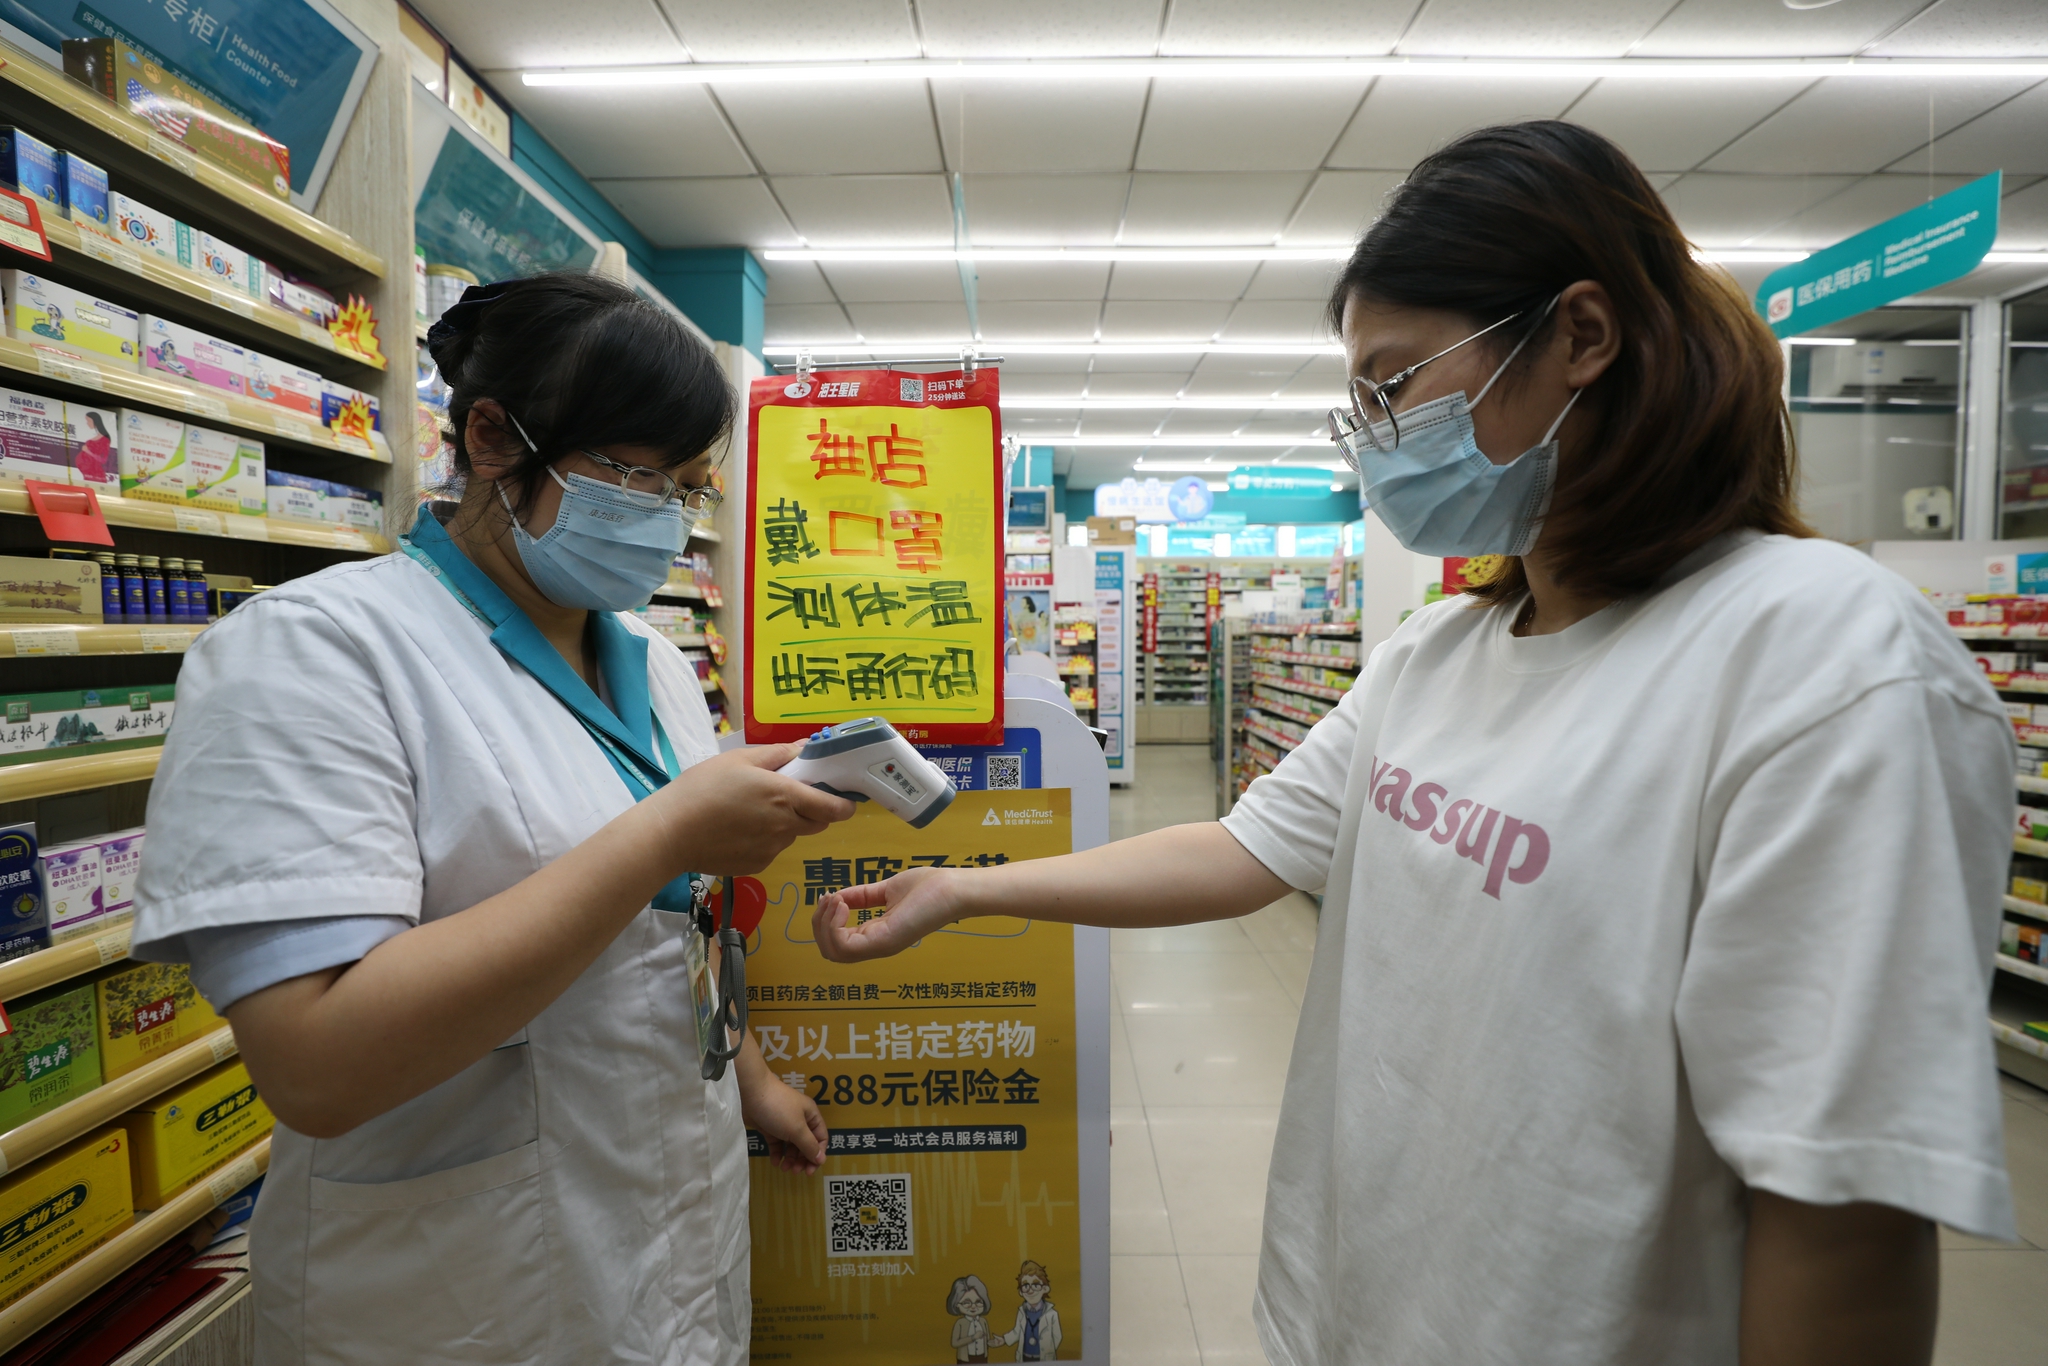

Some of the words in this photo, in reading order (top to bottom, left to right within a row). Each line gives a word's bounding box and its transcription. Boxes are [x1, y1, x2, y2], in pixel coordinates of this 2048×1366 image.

[147, 0, 218, 45] 专柜
[226, 49, 273, 88] Counter
[231, 34, 271, 69] Health
[270, 63, 299, 88] Food
[1884, 231, 1925, 256] Medical
[1924, 210, 1980, 240] Insurance
[1797, 259, 1873, 307] 医保用药
[1883, 254, 1930, 279] Medicine
[818, 382, 861, 398] 海王星辰
[927, 378, 964, 391] 扫码下单
[927, 391, 966, 401] 25分钟送达
[807, 418, 928, 489] 进店
[764, 497, 944, 574] 戴口罩
[765, 581, 982, 629] 测体温
[772, 647, 979, 702] 出示通行码
[893, 772, 917, 797] 家测宝
[1004, 808, 1053, 818] MediTrust
[60, 871, 96, 886] DHA软胶囊
[745, 981, 1037, 1002] 项目药房全额自费一次性购买指定药物
[137, 1001, 174, 1032] 碧生源
[755, 1020, 1036, 1062] 及以上指定药物
[27, 1043, 70, 1079] 碧生源
[827, 1131, 1018, 1150] 费享受一站式会员服务福利
[827, 1262, 915, 1279] 扫码立刻加入
